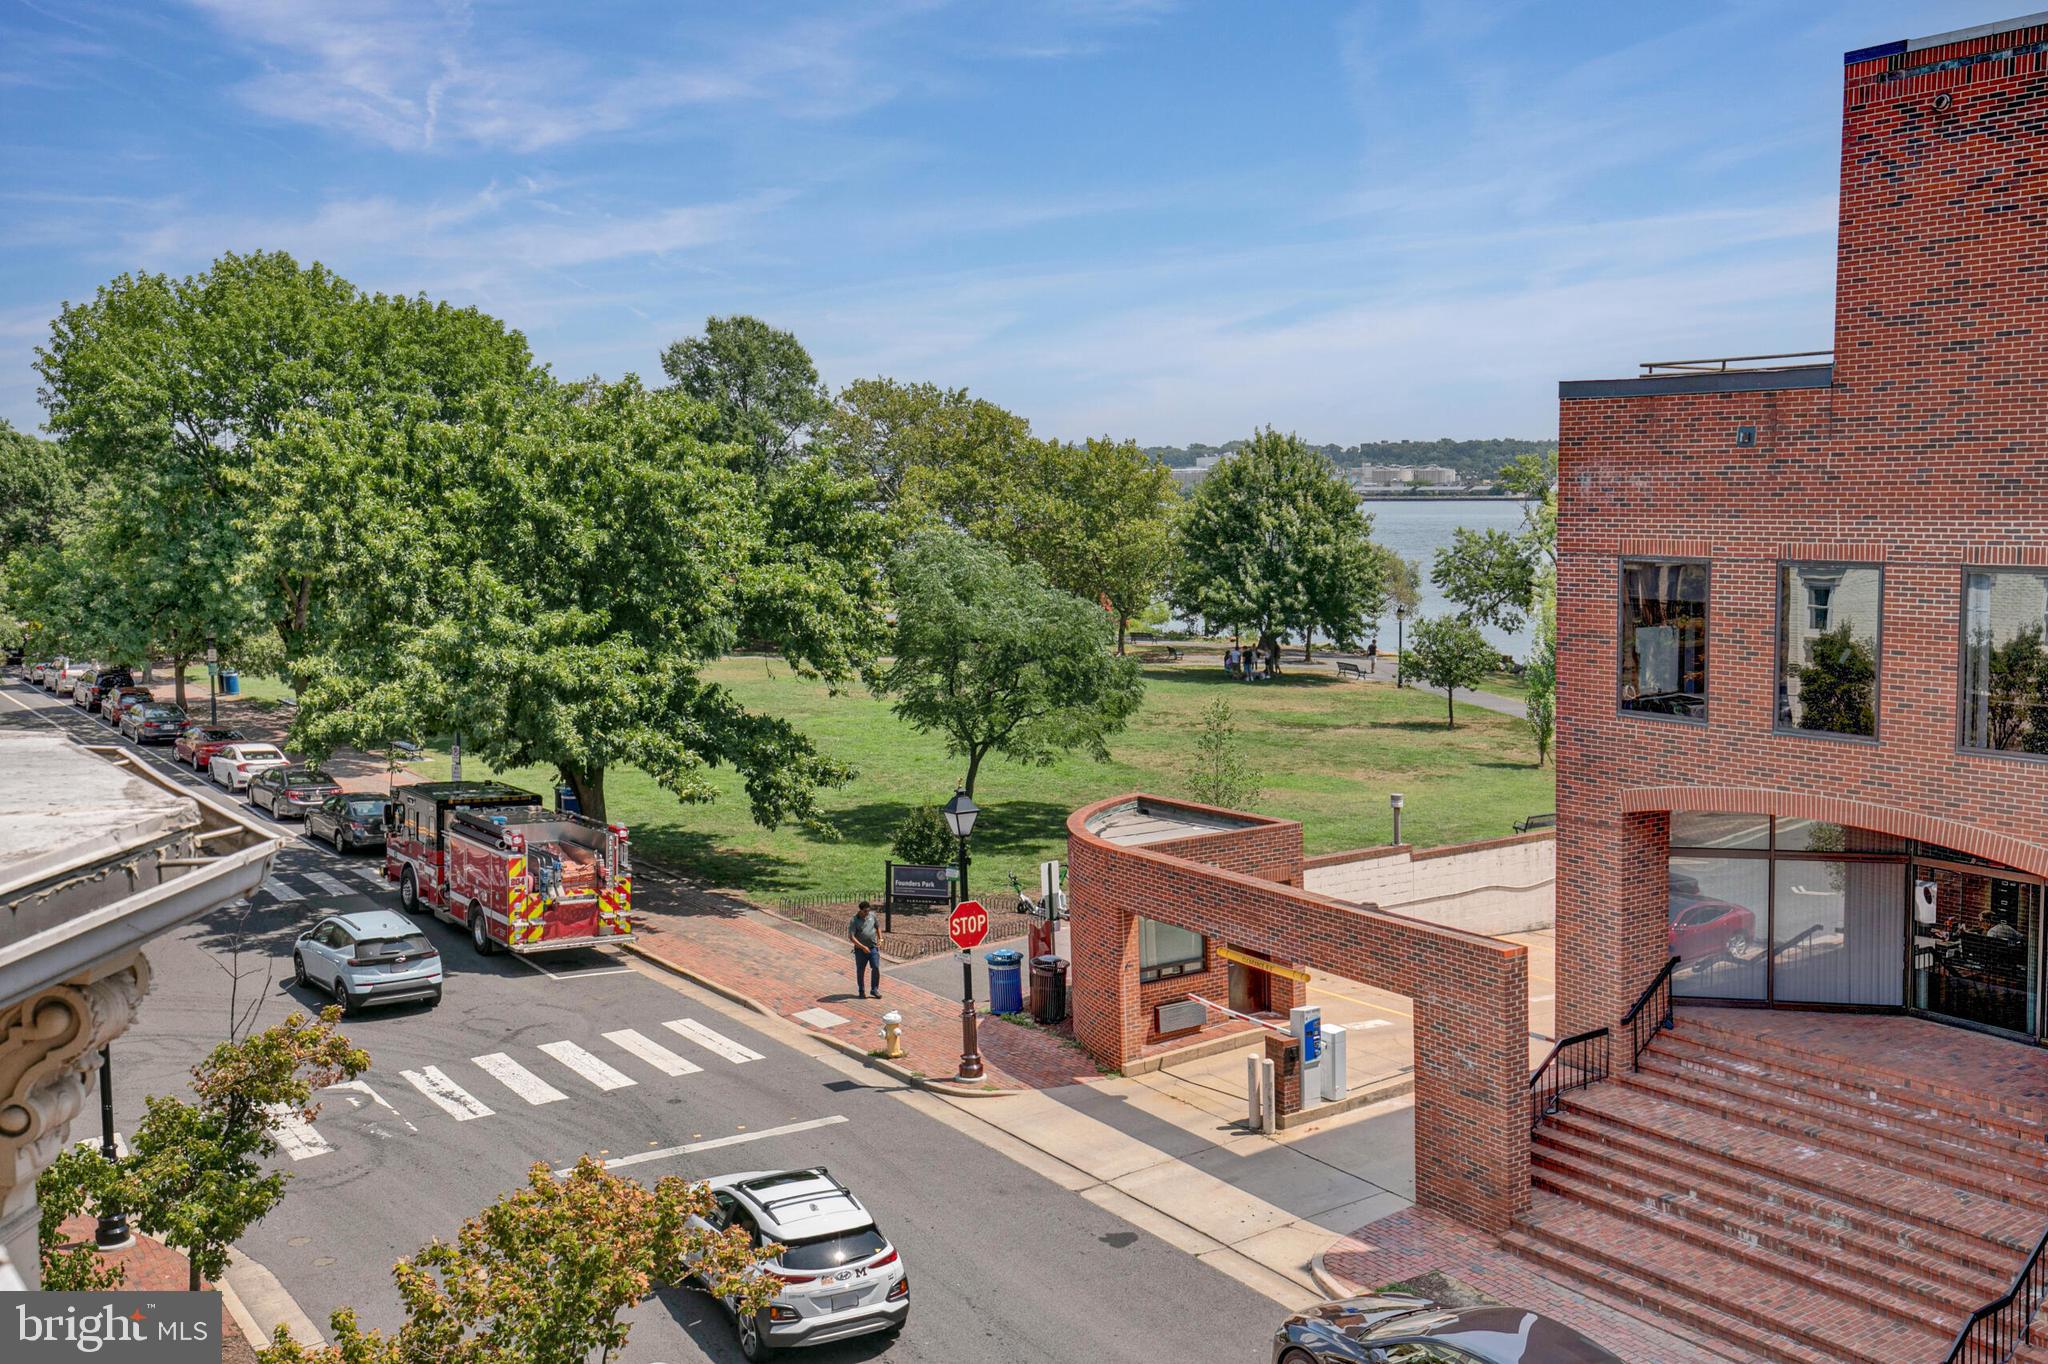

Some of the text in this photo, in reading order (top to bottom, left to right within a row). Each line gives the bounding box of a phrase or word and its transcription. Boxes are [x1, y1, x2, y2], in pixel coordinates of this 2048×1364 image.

[895, 880, 921, 888] Founders
[951, 914, 986, 936] STOP
[855, 1266, 868, 1279] M
